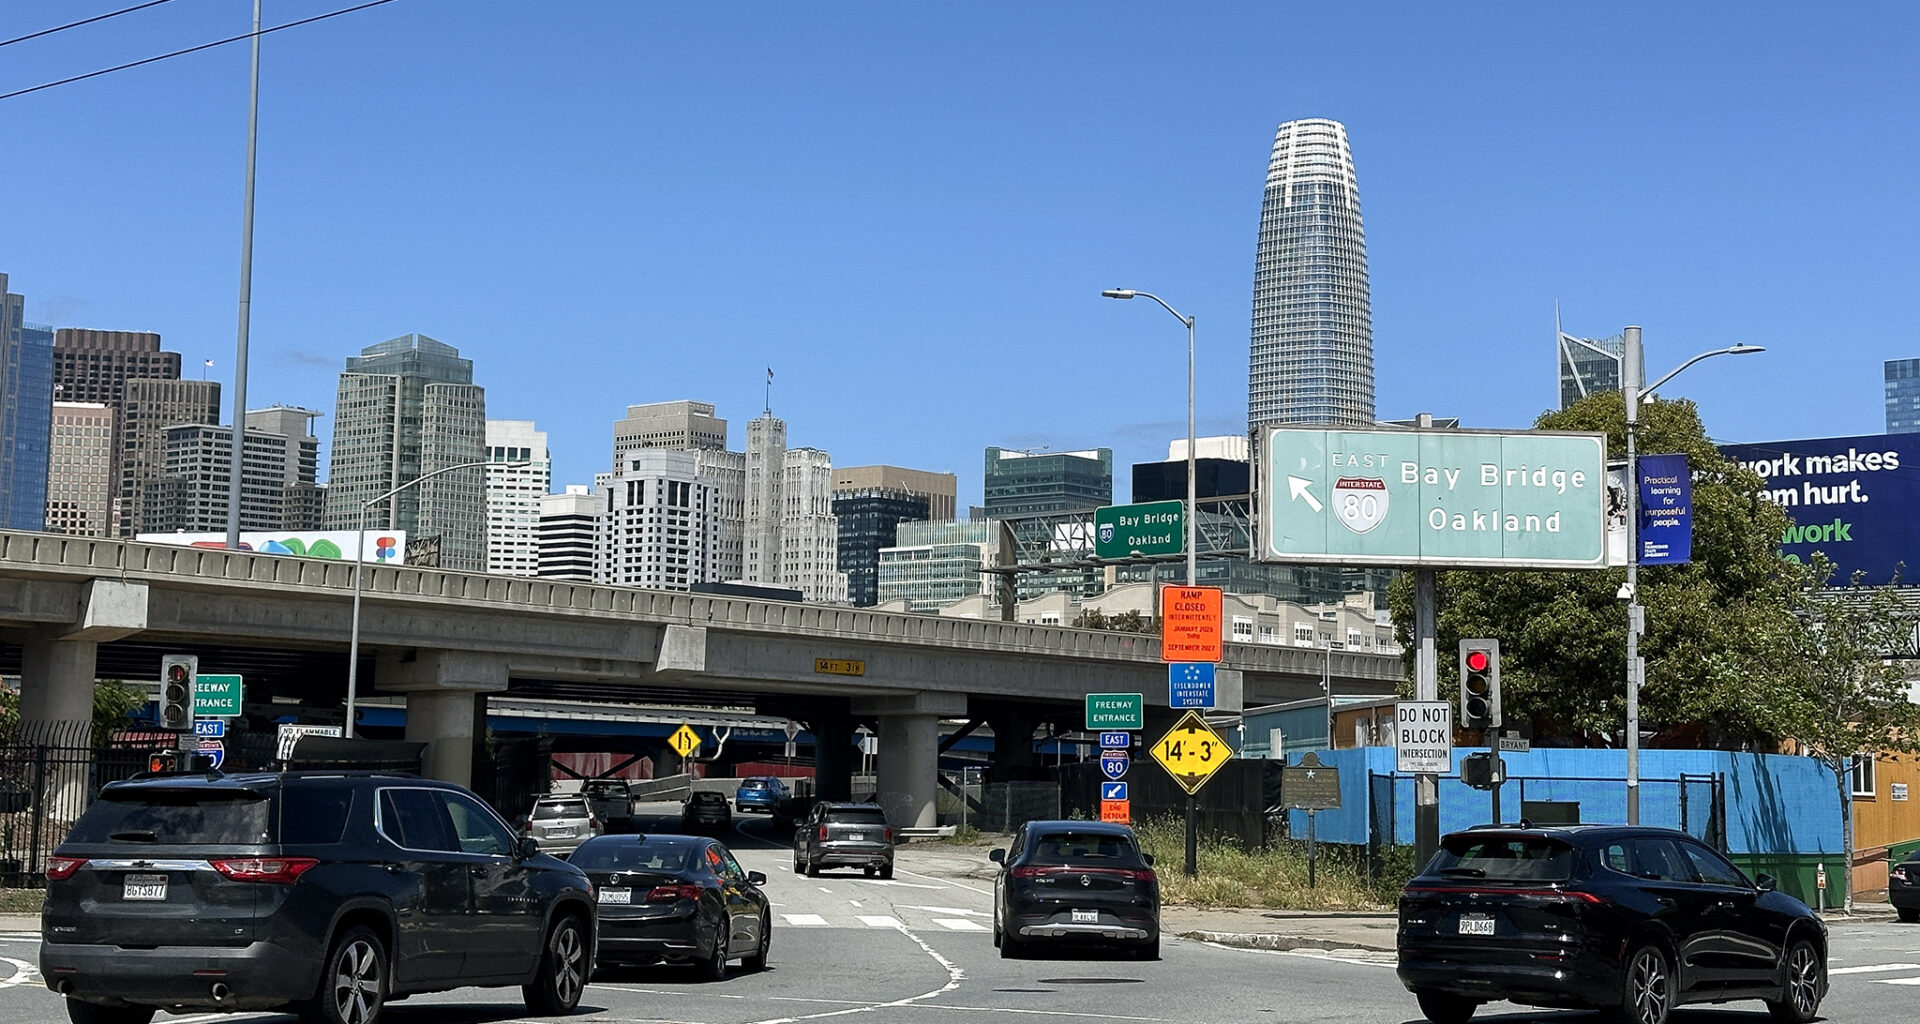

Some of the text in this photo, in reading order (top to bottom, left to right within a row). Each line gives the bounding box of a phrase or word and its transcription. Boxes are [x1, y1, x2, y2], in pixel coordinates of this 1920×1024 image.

[1332, 454, 1388, 468] EAST
[1806, 448, 1900, 474] makes
[1401, 462, 1460, 490] Bay
[1481, 464, 1586, 495] Bridge
[1644, 476, 1678, 484] Practical
[1339, 481, 1382, 489] INTERSTATE
[1651, 486, 1681, 495] learning
[1804, 479, 1870, 505] hurt.
[1663, 496, 1675, 505] for
[1343, 494, 1378, 521] 80
[1645, 507, 1686, 517] purposeful
[1120, 513, 1179, 527] Bay Bridge
[1428, 507, 1560, 532] Oakland
[1653, 518, 1680, 527] people.
[1101, 530, 1112, 539] 80
[1128, 533, 1171, 546] Oakland
[1180, 591, 1202, 600] RAMP
[1174, 602, 1206, 611] CLOSED
[195, 683, 230, 692] EEWAY
[195, 698, 233, 707] TRANCE
[1400, 708, 1448, 722] DO NOT
[196, 724, 218, 734] EAST
[1105, 735, 1124, 744] EAST
[1402, 729, 1446, 743] BLOCK
[1501, 740, 1527, 749] BRYANT
[1400, 749, 1447, 759] INTERSECTION
[1107, 762, 1123, 773] 80
